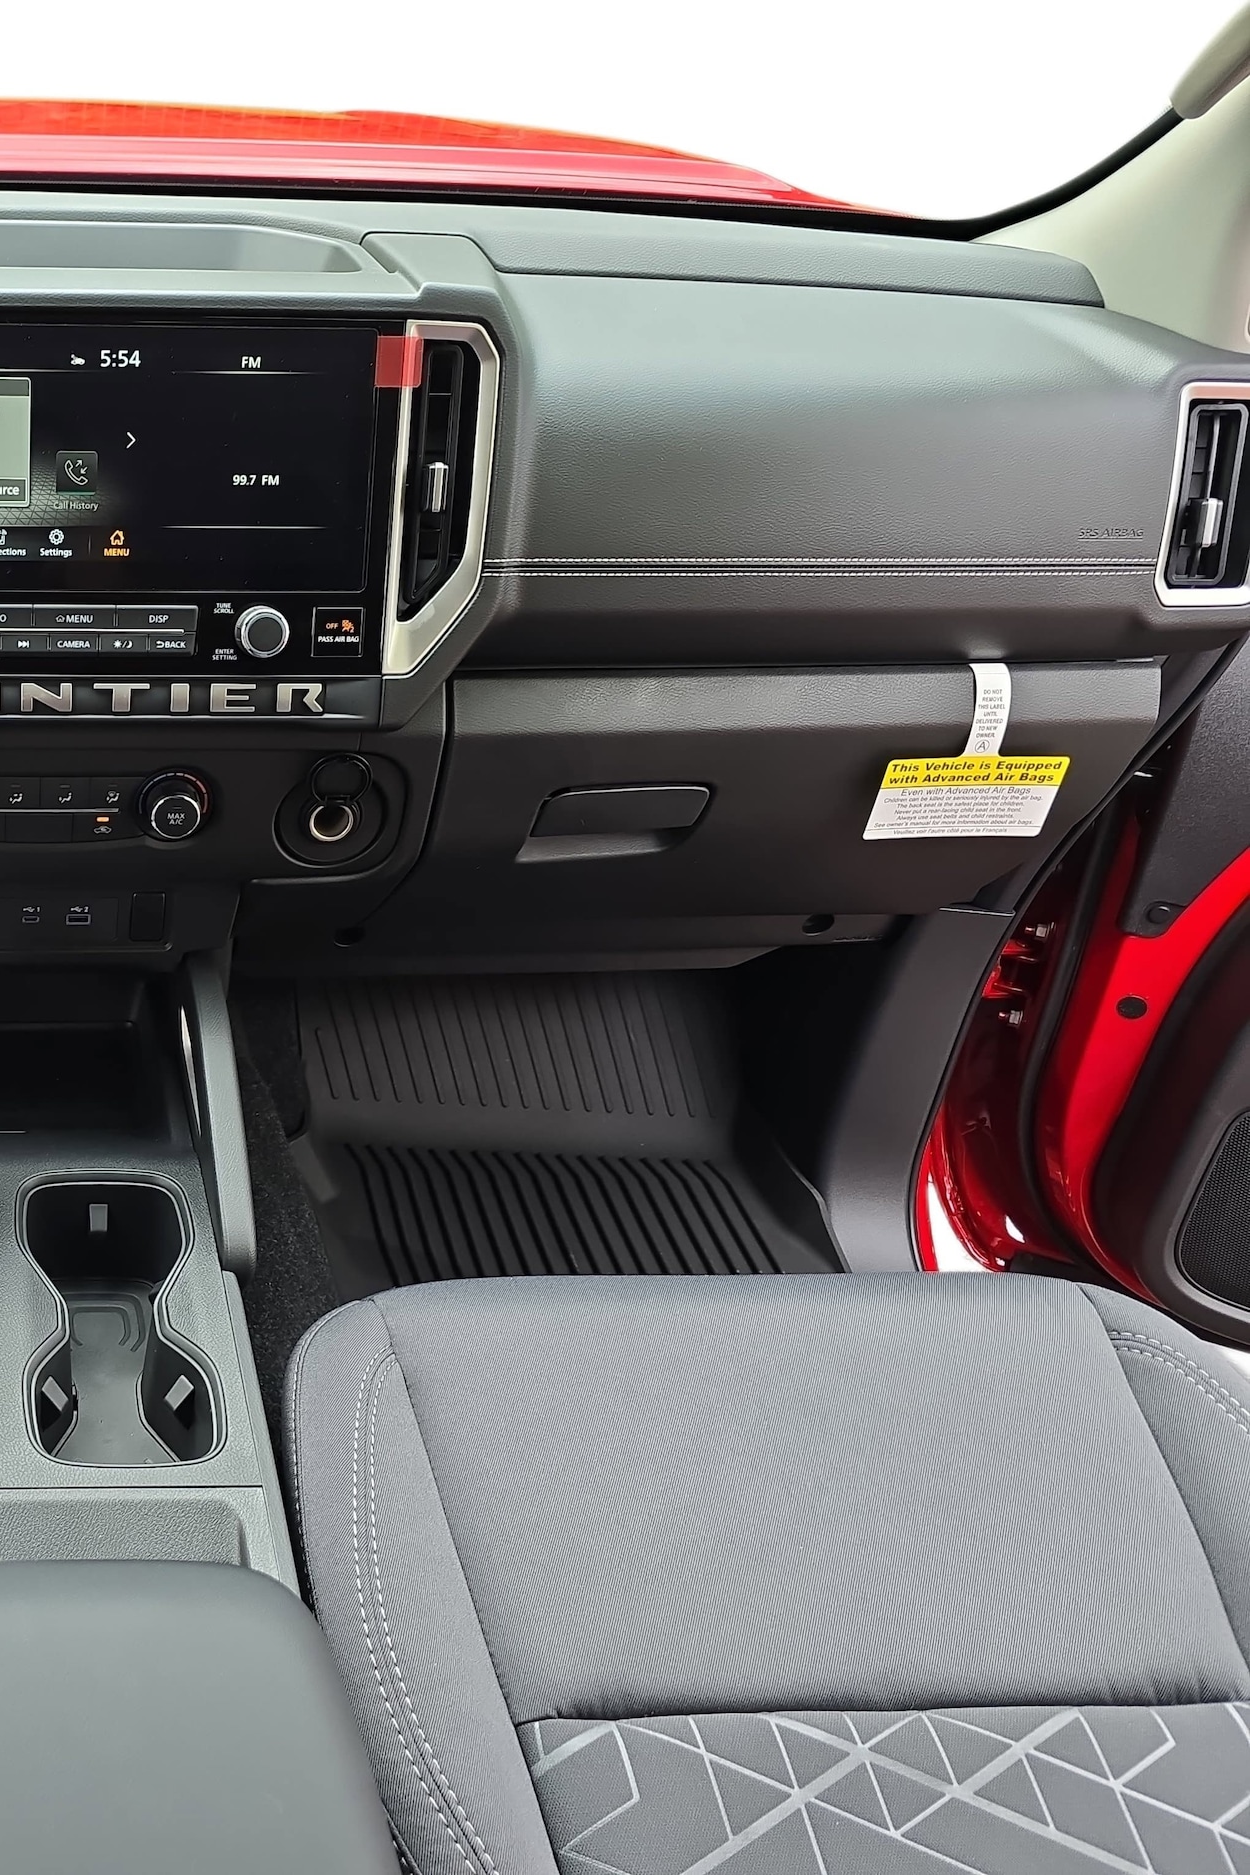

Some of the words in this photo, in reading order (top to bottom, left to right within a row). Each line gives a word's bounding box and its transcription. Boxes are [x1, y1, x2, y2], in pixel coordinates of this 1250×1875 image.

[99, 349, 141, 368] 5:54
[241, 356, 262, 369] FM
[232, 474, 257, 486] 99.7
[261, 474, 280, 486] FM
[53, 501, 70, 511] Call
[70, 501, 99, 512] History
[1078, 527, 1099, 538] SRS
[1101, 527, 1145, 538] AIRBAG
[39, 547, 73, 559] Settings
[103, 547, 130, 557] MENU
[65, 614, 94, 623] MENU
[148, 614, 170, 623] DISP
[325, 622, 339, 630] OFF
[317, 635, 334, 643] PASS
[334, 635, 346, 643] AIR
[346, 635, 360, 643] BAG
[56, 640, 91, 649] CAMERA
[165, 640, 187, 649] BACK
[891, 763, 920, 773] This
[925, 762, 975, 771] Vehicle
[979, 761, 992, 770] is
[995, 760, 1063, 772] Equipped
[888, 774, 919, 784] with
[921, 772, 991, 783] Advanced
[994, 772, 1017, 781] Air
[1019, 772, 1055, 784] Bags
[900, 788, 923, 797] Even
[945, 787, 990, 795] Advanced
[1007, 787, 1031, 796] Bags
